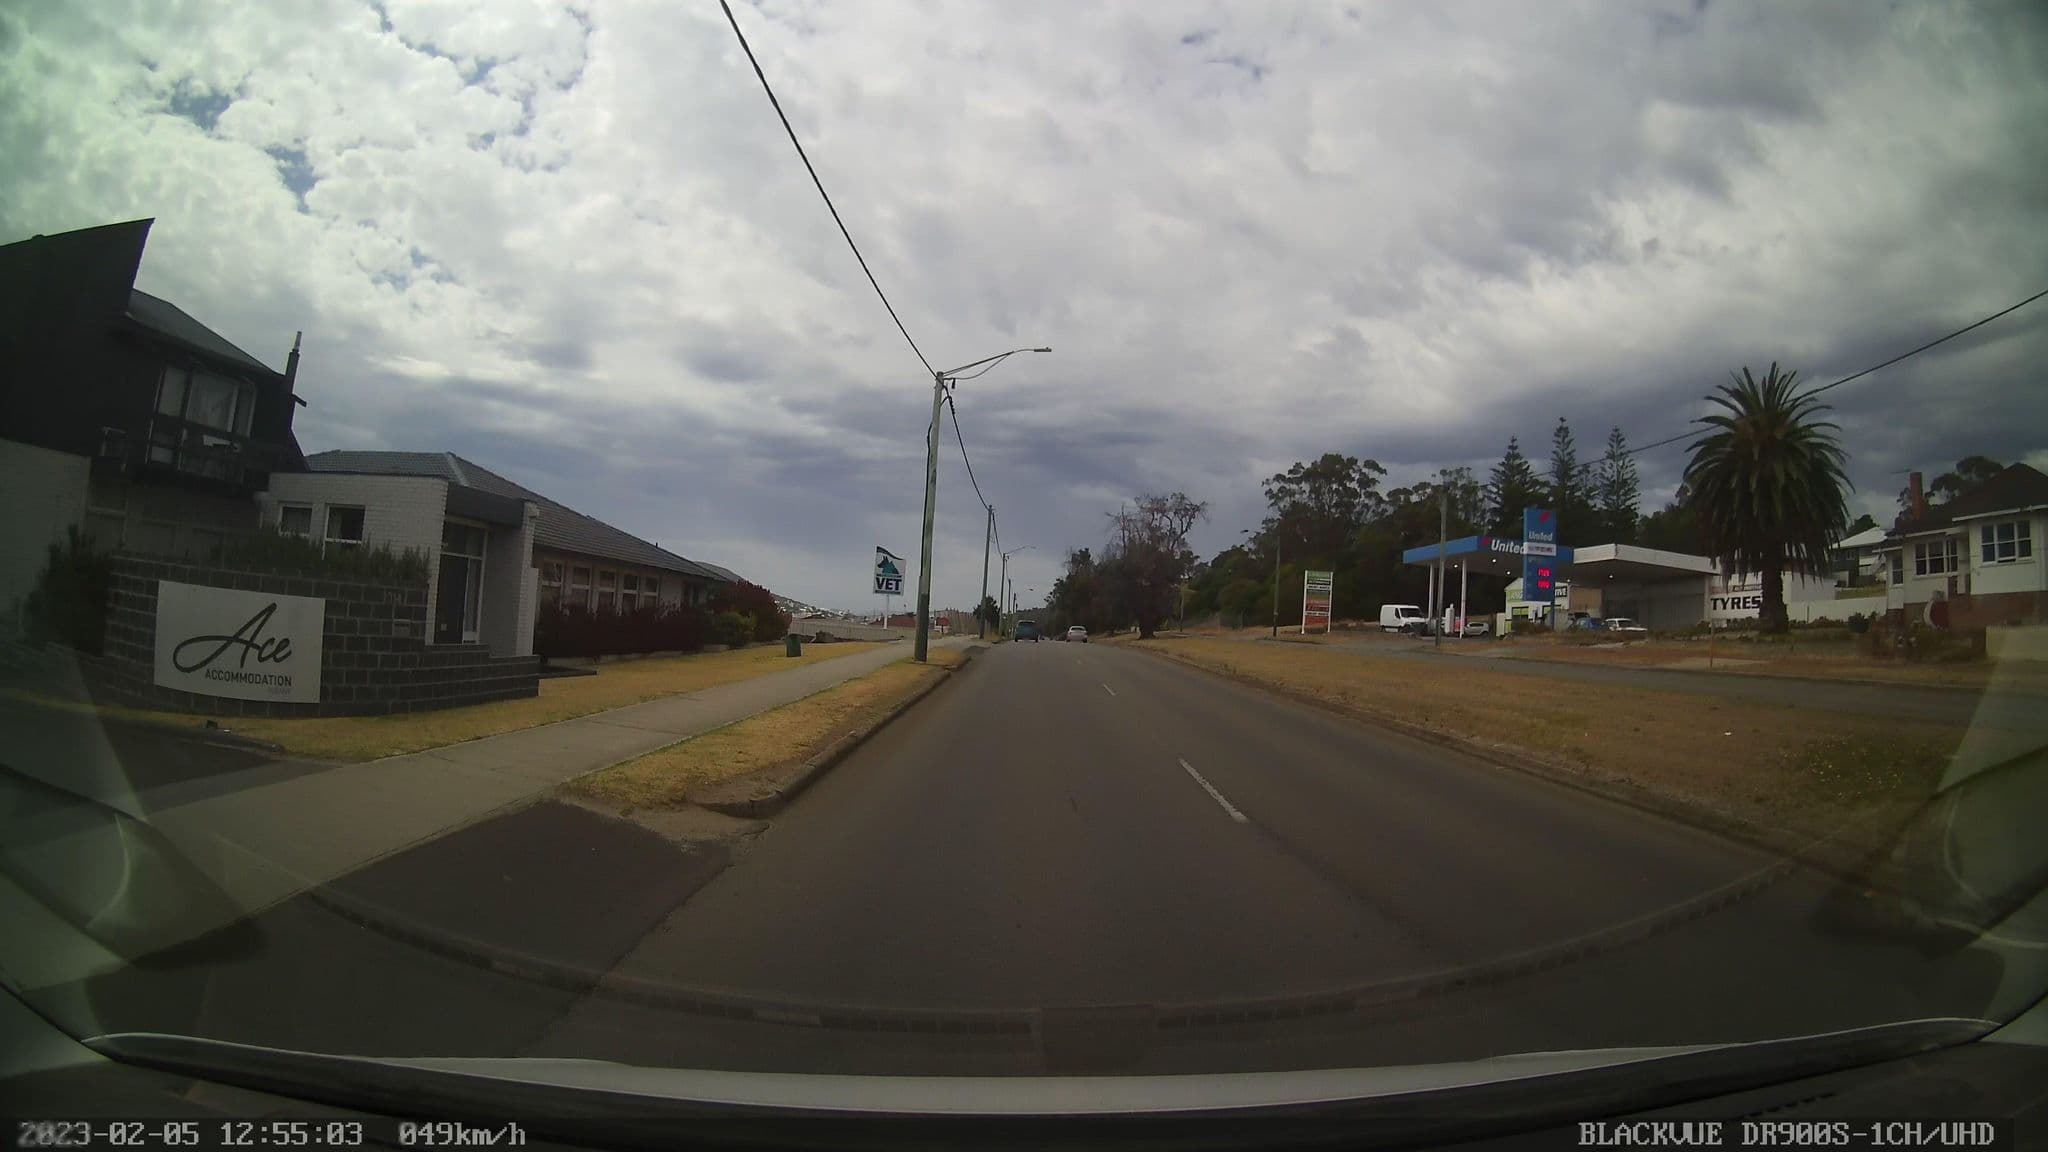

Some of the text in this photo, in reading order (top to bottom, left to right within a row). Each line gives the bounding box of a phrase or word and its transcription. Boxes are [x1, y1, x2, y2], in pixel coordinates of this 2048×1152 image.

[1529, 530, 1553, 541] United
[1491, 539, 1527, 554] United
[876, 577, 902, 591] VET
[1710, 596, 1761, 611] TYRES
[173, 602, 292, 673] Ace
[205, 669, 292, 687] ACCOMMODATION
